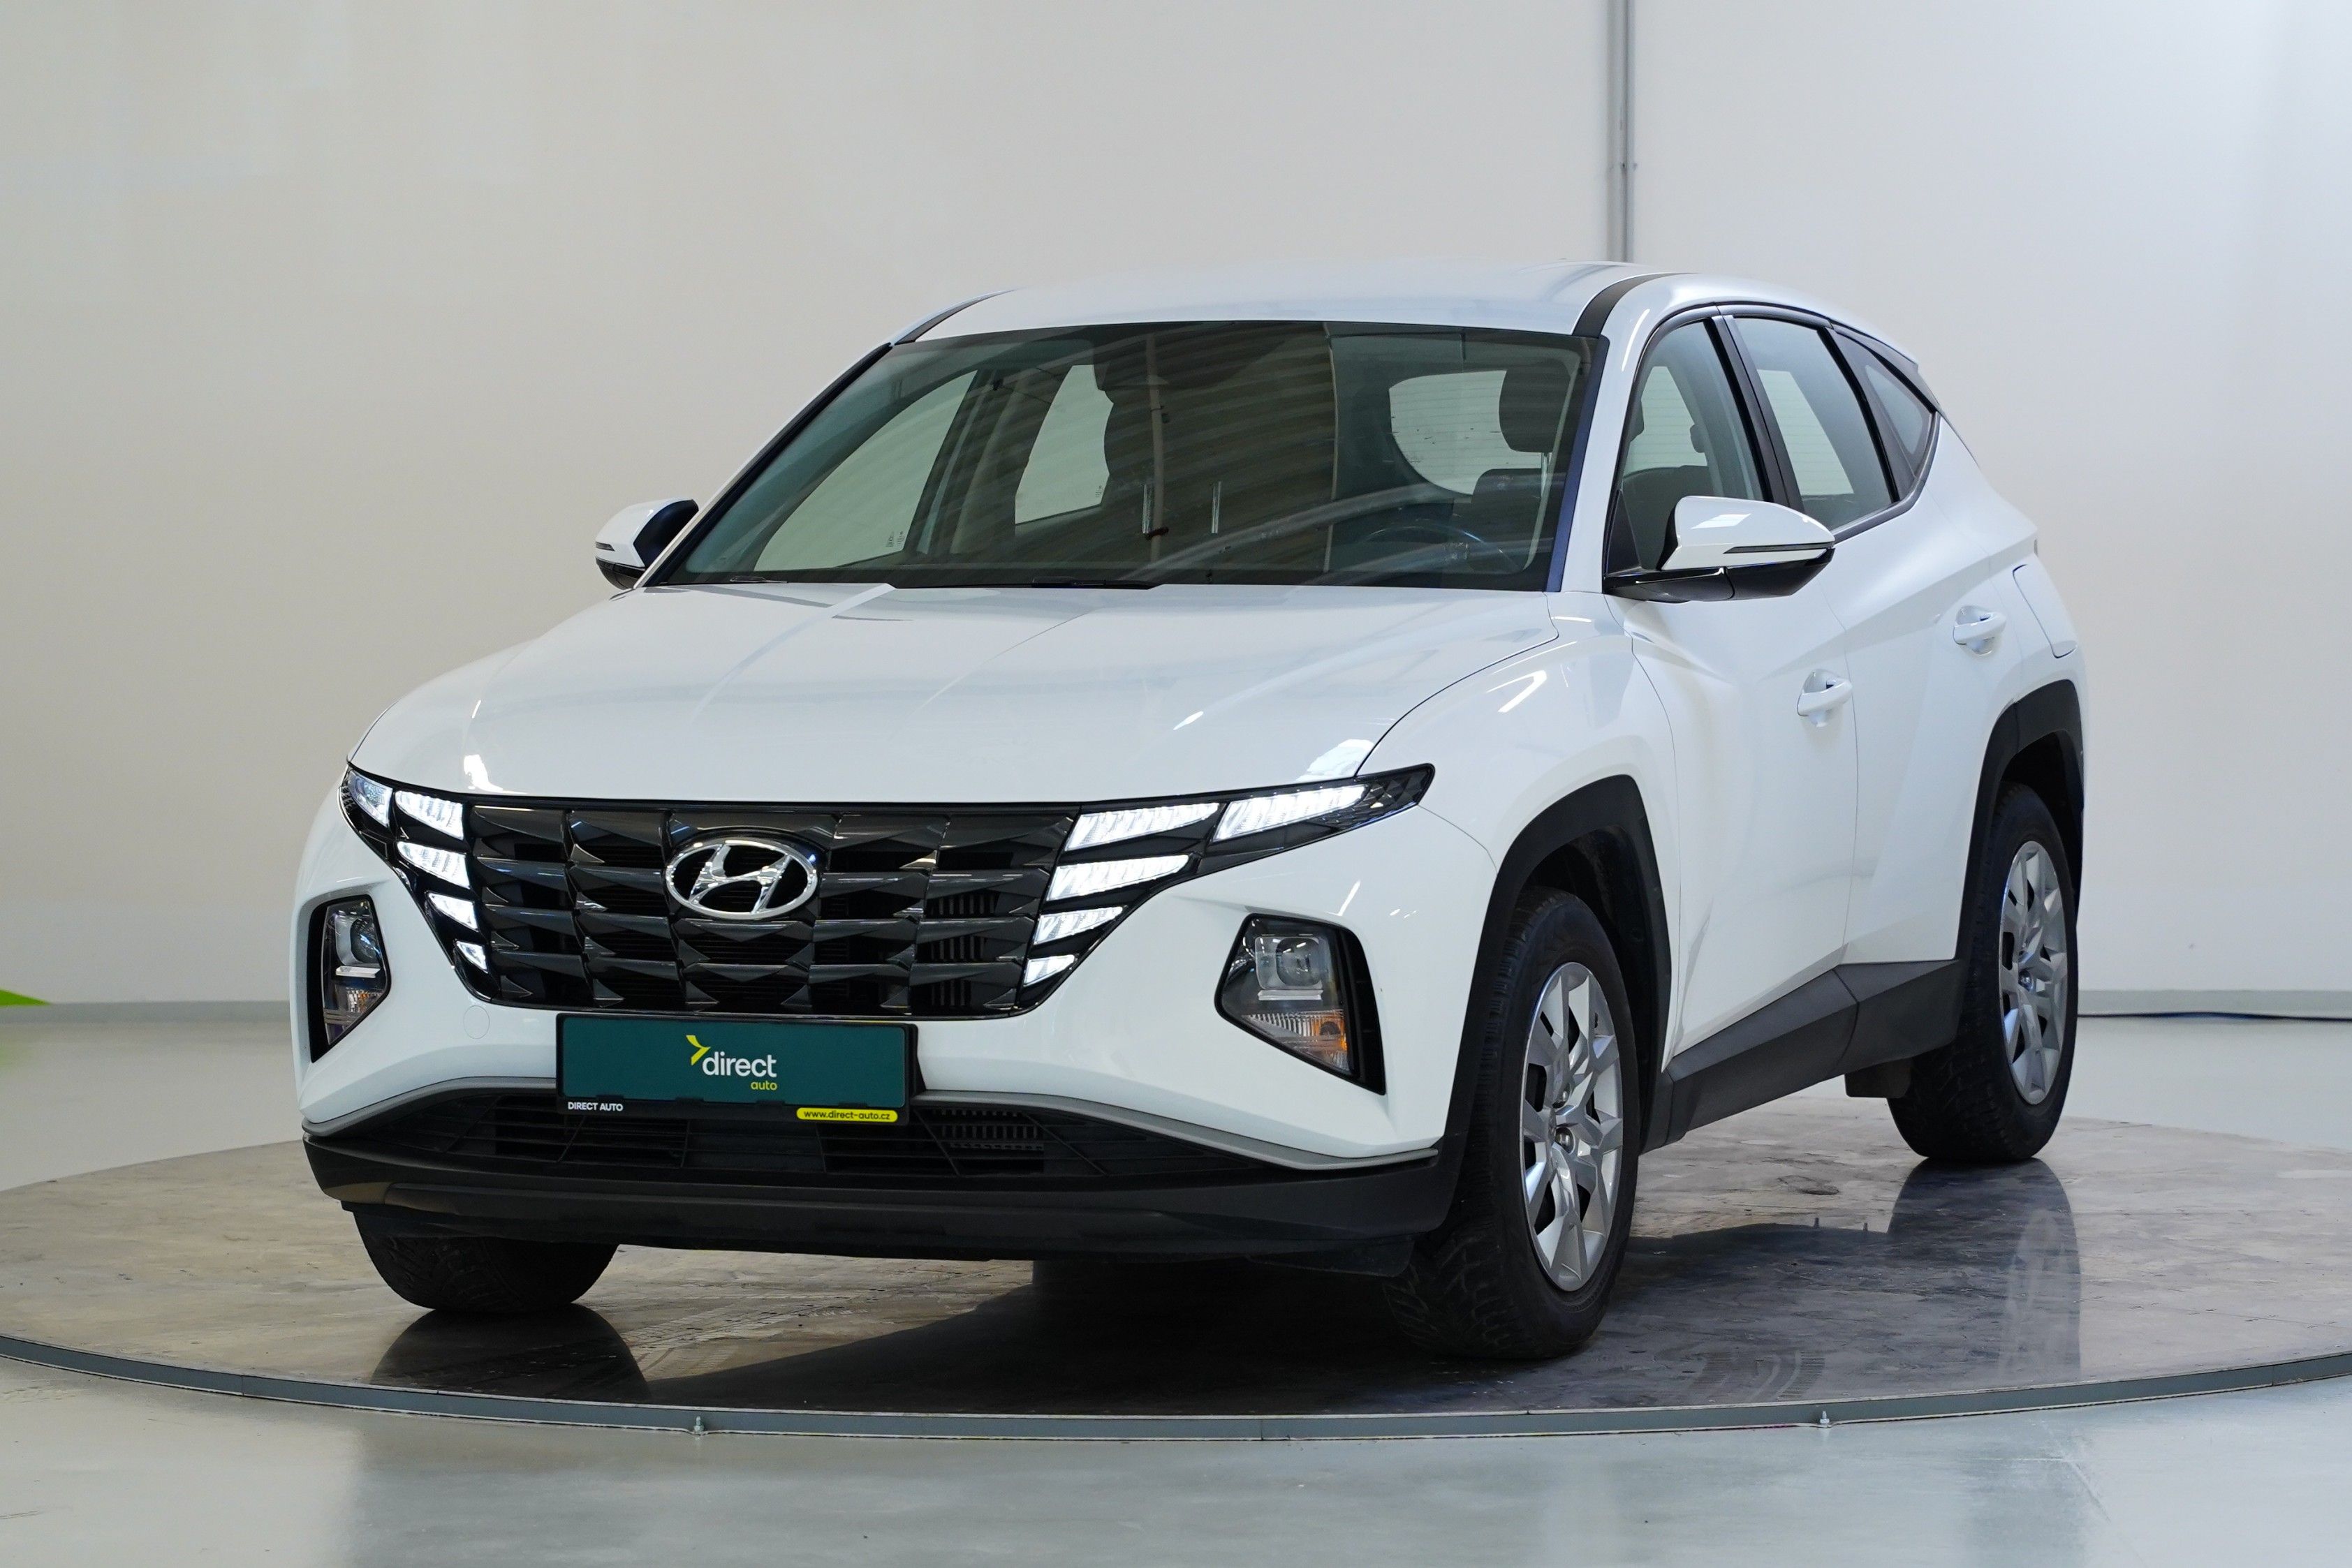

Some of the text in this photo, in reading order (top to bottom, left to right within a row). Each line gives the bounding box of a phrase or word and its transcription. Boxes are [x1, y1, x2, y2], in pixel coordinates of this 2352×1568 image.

[702, 1051, 777, 1078] direct
[750, 1080, 778, 1090] auto
[567, 1102, 624, 1112] DIRECT AUTO
[804, 1110, 890, 1120] www.direct-auto.cz
